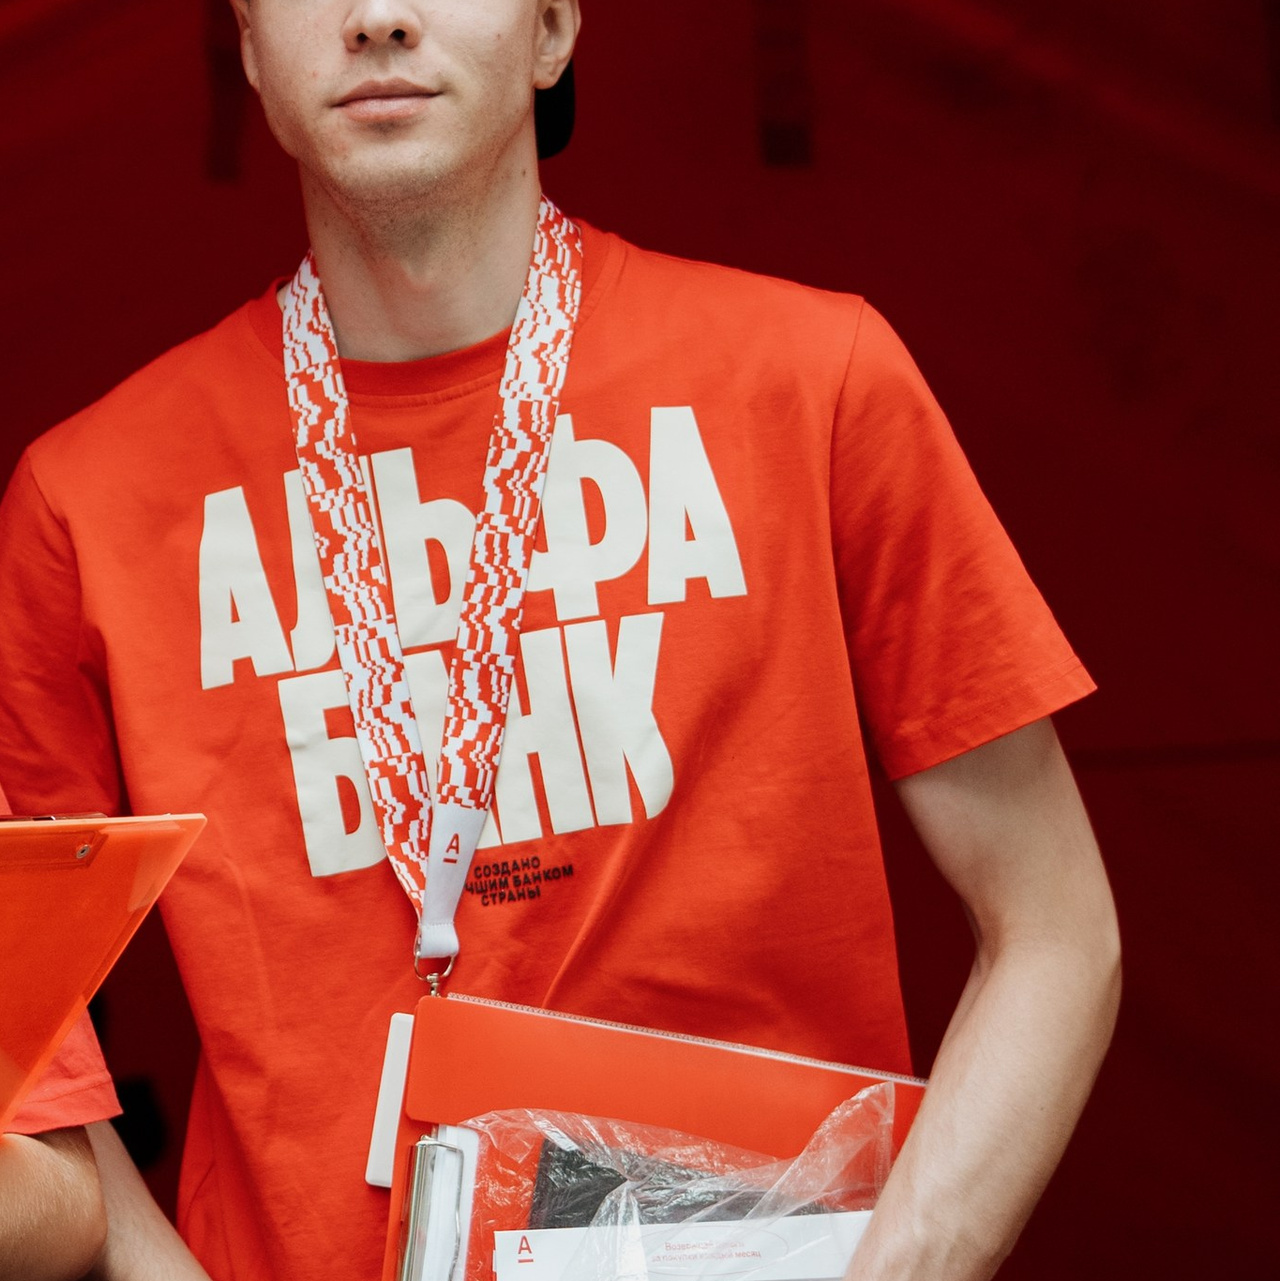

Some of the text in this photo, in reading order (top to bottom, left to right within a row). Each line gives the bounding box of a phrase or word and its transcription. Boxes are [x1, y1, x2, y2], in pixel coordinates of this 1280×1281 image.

[474, 856, 541, 879] СОЗДАНО
[465, 864, 574, 895] ЧШИМ БАНКОМ
[481, 886, 541, 907] СТРАНЫ
[735, 1250, 762, 1259] месяц
